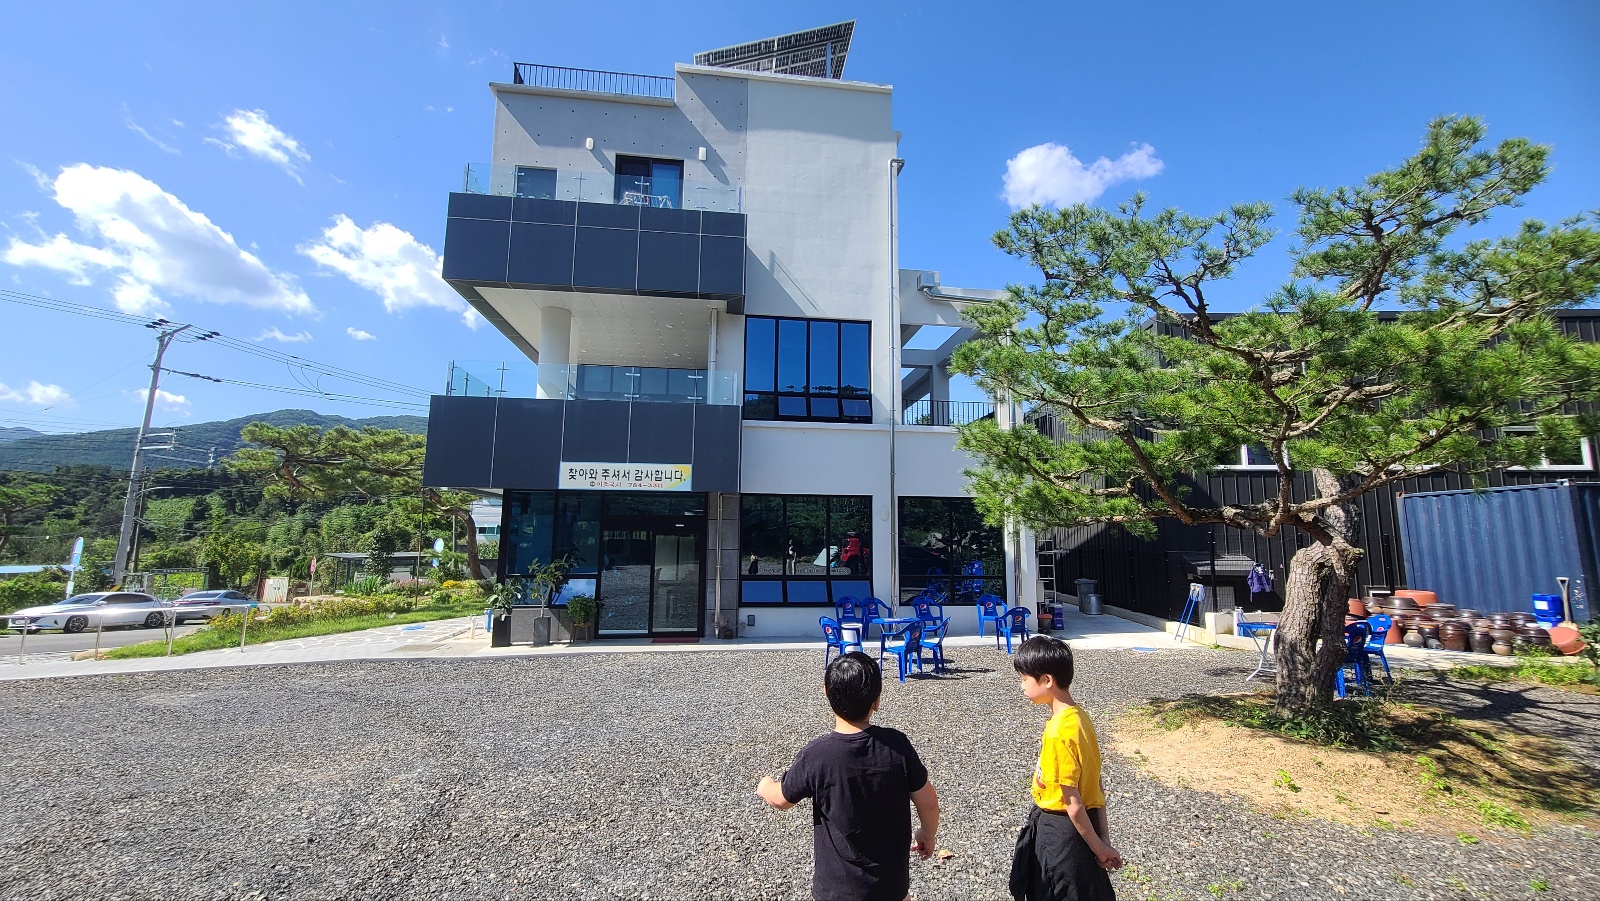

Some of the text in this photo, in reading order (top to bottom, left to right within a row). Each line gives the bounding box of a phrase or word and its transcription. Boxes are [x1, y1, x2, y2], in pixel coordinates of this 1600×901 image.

[568, 467, 686, 482] 찾아와 주셔서 감사합니다.
